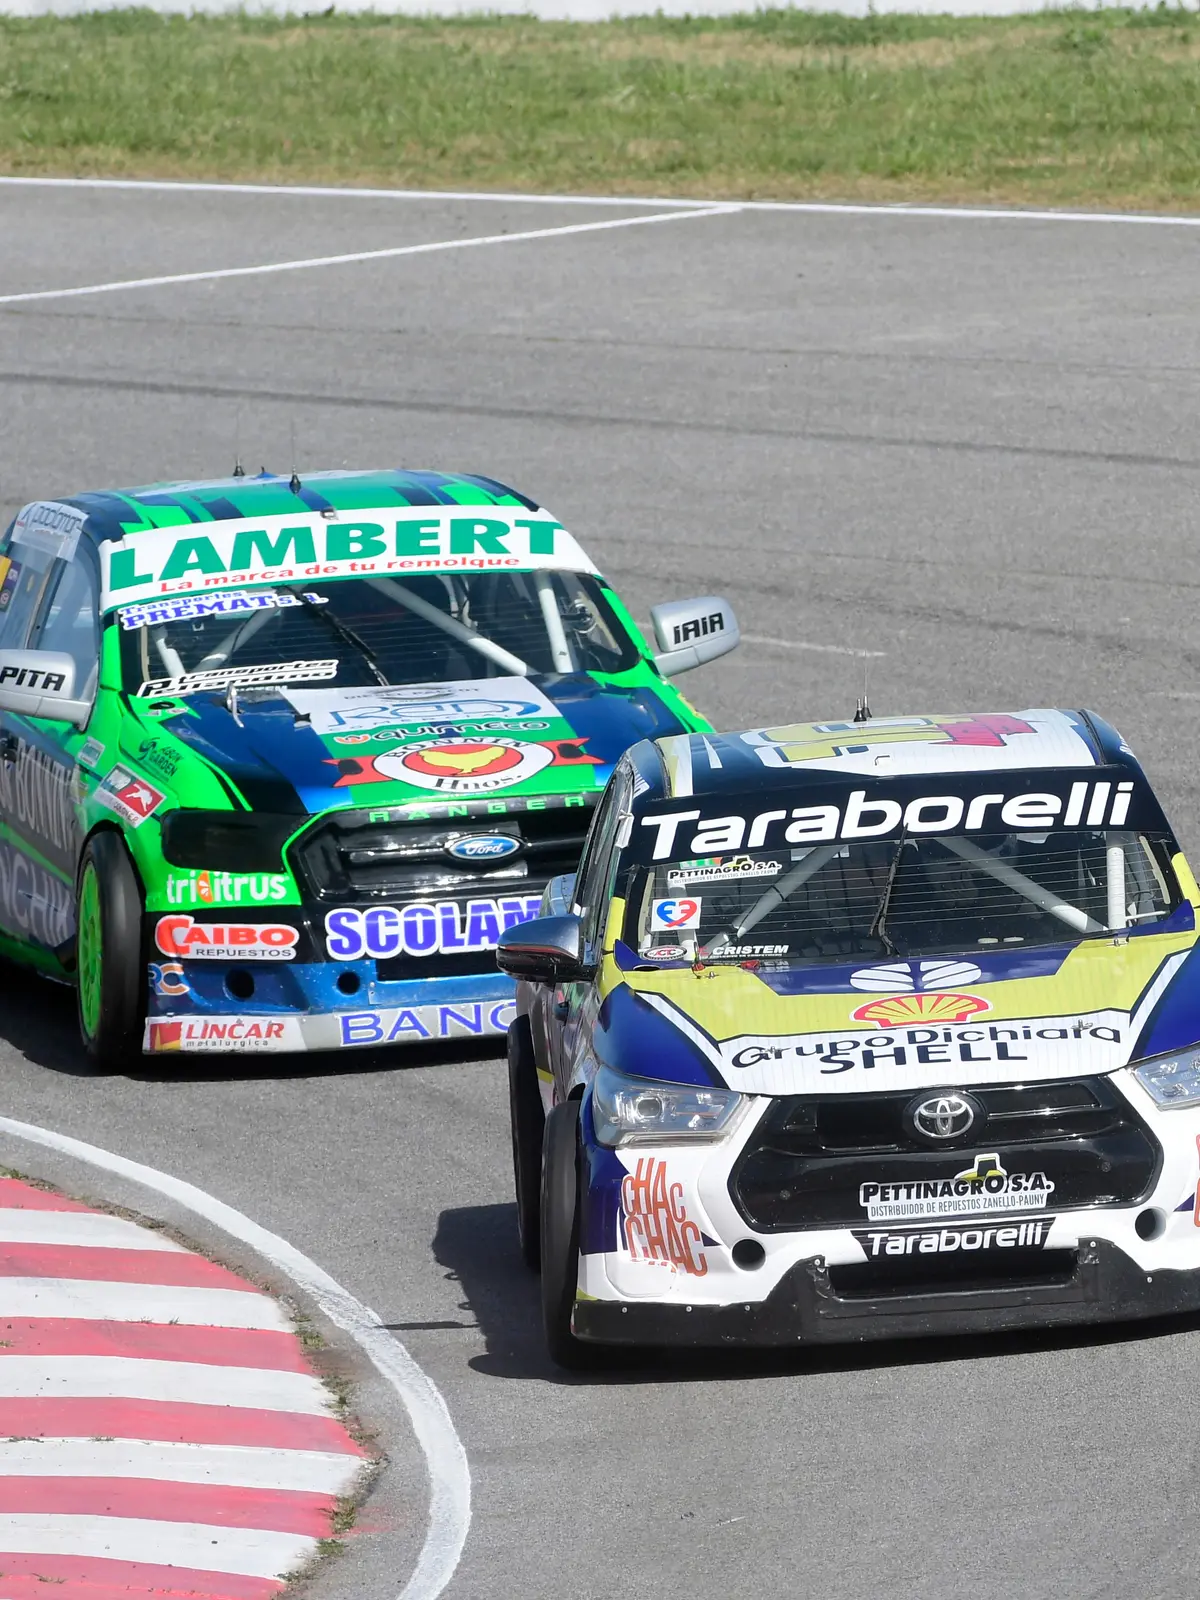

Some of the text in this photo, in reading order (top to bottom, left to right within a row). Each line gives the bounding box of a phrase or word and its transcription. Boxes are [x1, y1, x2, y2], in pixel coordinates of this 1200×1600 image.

[109, 519, 564, 592] LAMBERT
[161, 556, 520, 592] La marca de tu remolque
[121, 591, 243, 616] Transportes
[385, 737, 530, 758] BONNIN
[368, 796, 585, 823] RANGER
[640, 781, 1134, 860] Taraborelli
[464, 839, 504, 856] Ford
[157, 917, 295, 955] CAIBO
[712, 945, 789, 955] CRISTEM
[196, 948, 292, 957] REPUESTOS
[185, 1022, 285, 1040] LINCAR
[731, 1025, 1121, 1068] Grupo Dichiara
[820, 1042, 1028, 1074] SHELL
[622, 1157, 686, 1223] CHAC
[862, 1173, 1052, 1203] PETTINAGRO S.A.
[870, 1193, 1045, 1217] DISTRIBUIDOR DE REPUESTOS ZANELLO-PAUNY
[625, 1208, 708, 1277] CHAC
[867, 1222, 1043, 1256] Taraborelli
